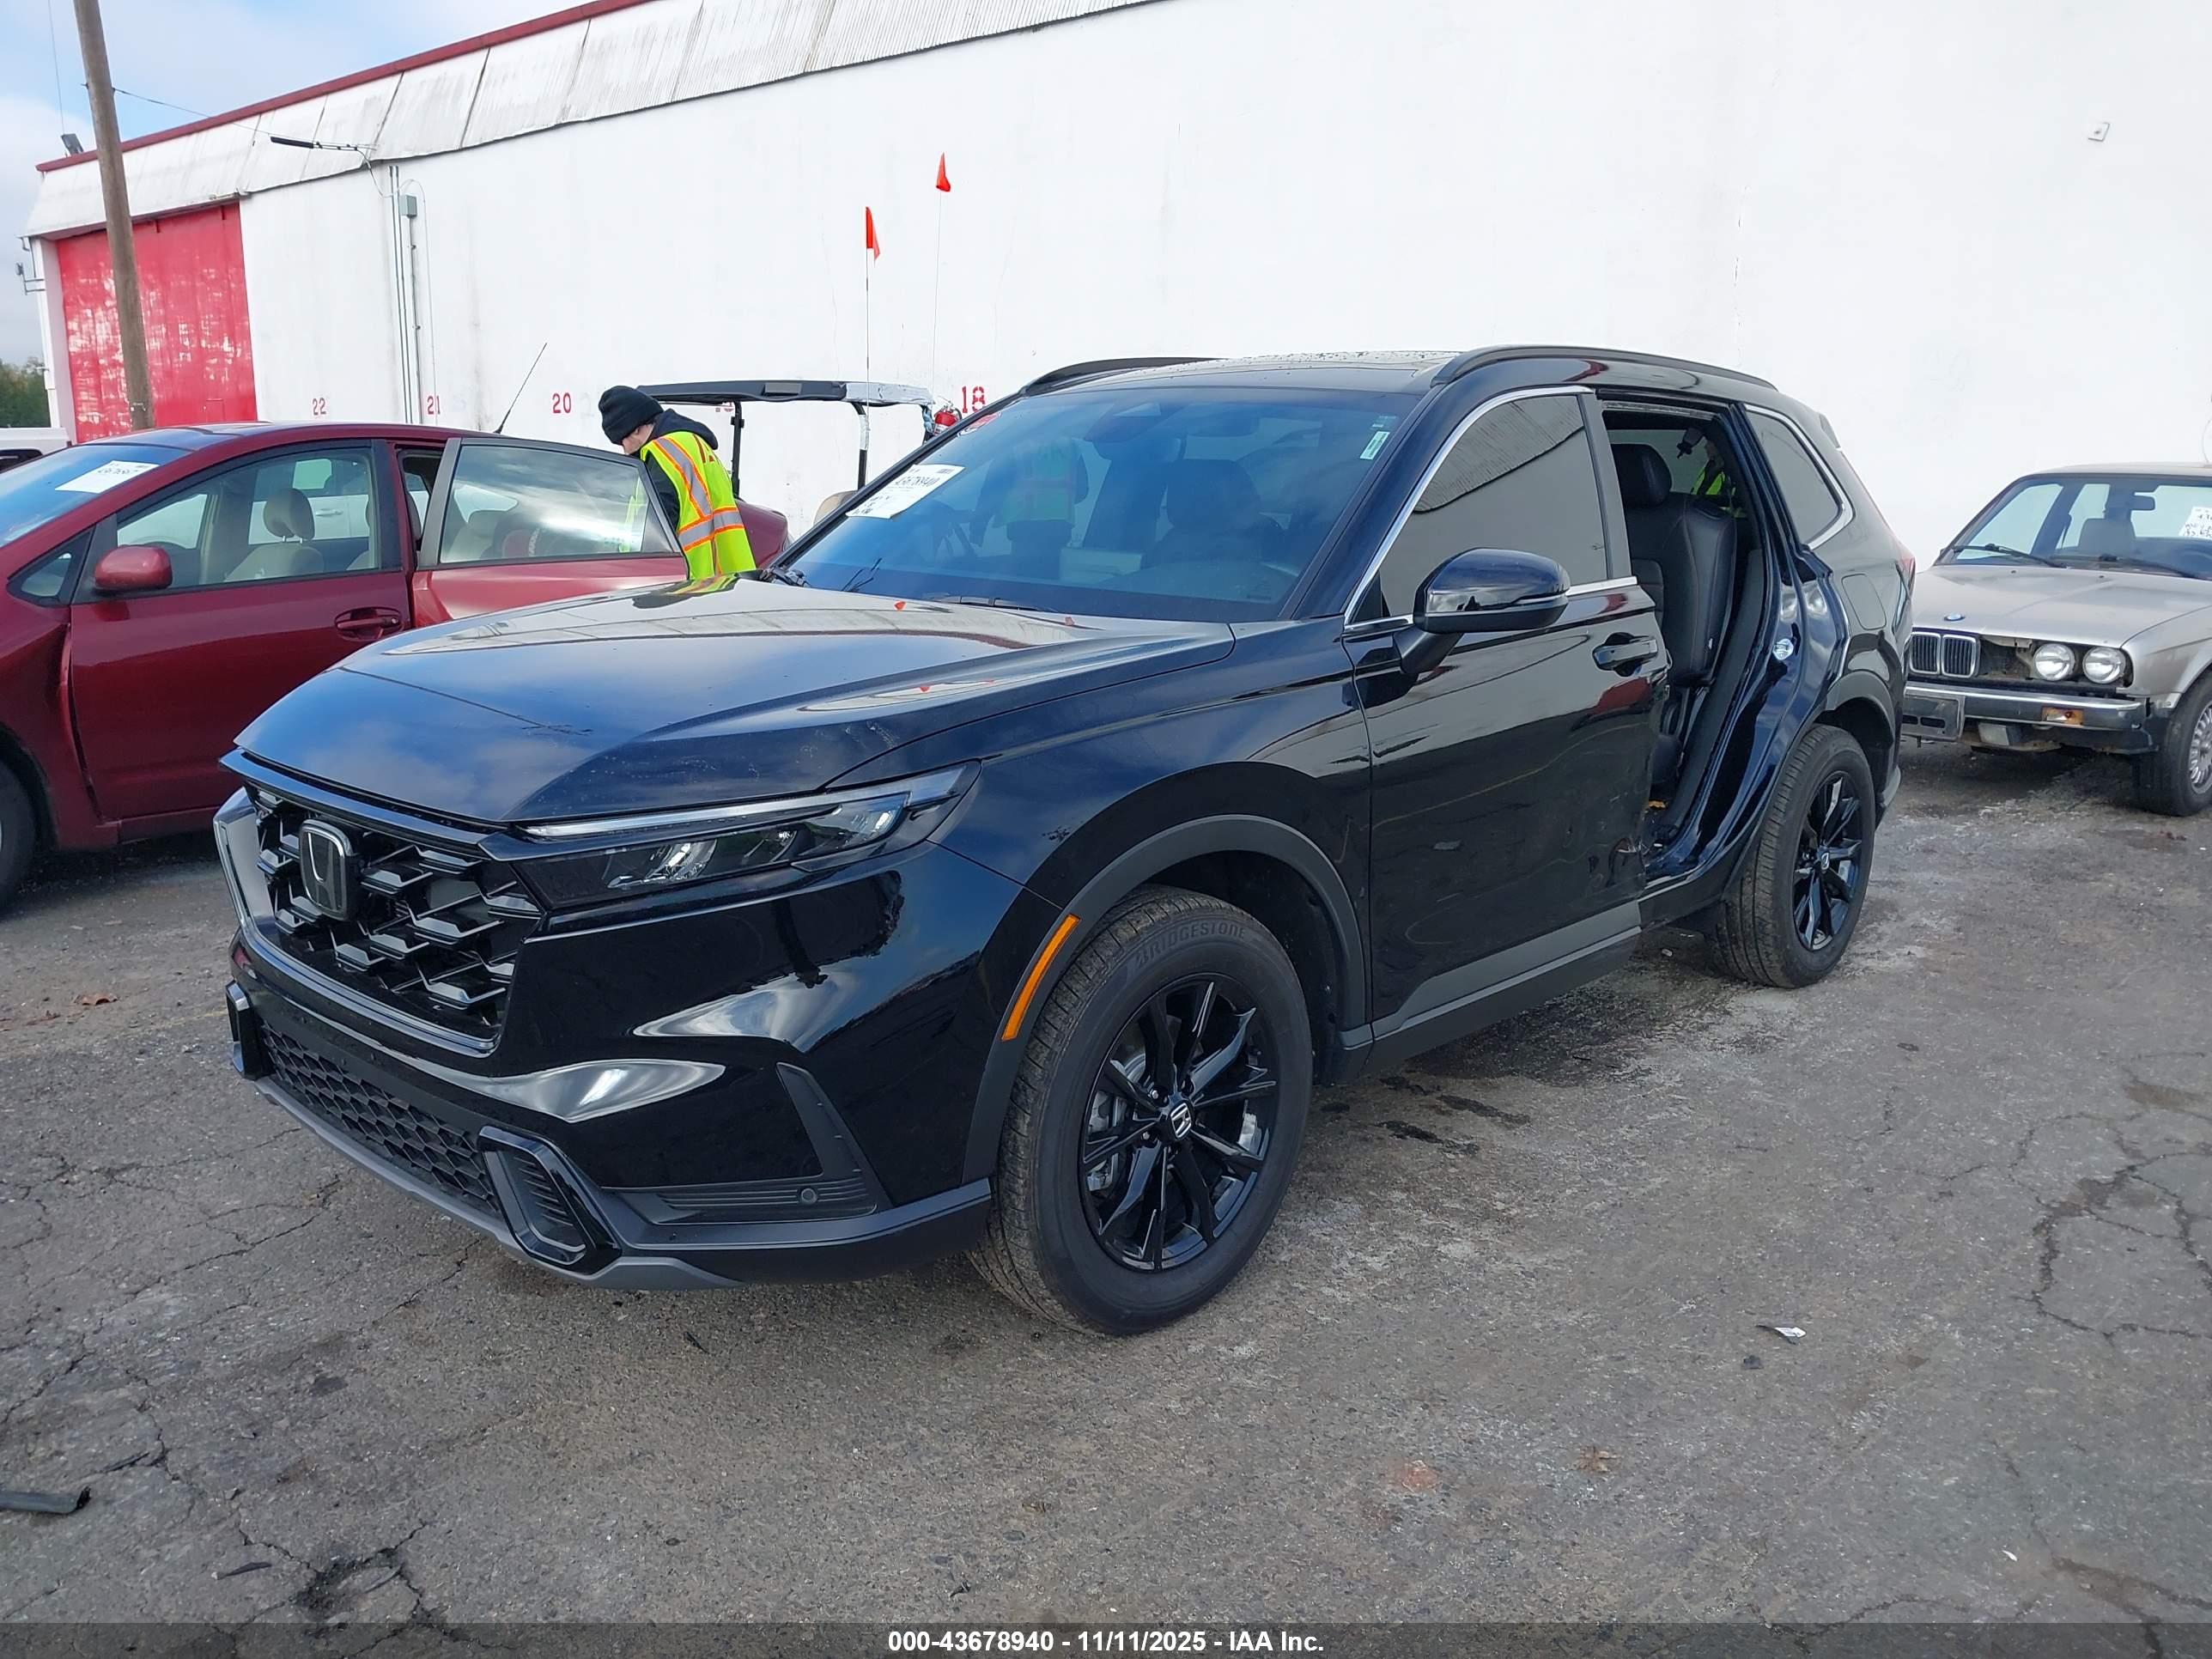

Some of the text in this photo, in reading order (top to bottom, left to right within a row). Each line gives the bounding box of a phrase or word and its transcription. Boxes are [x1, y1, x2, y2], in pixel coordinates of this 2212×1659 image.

[312, 397, 327, 416] 22
[427, 395, 441, 415] 21
[552, 392, 572, 414] 20
[962, 386, 986, 413] 18
[1133, 921, 1246, 966] BRIDGESTONE
